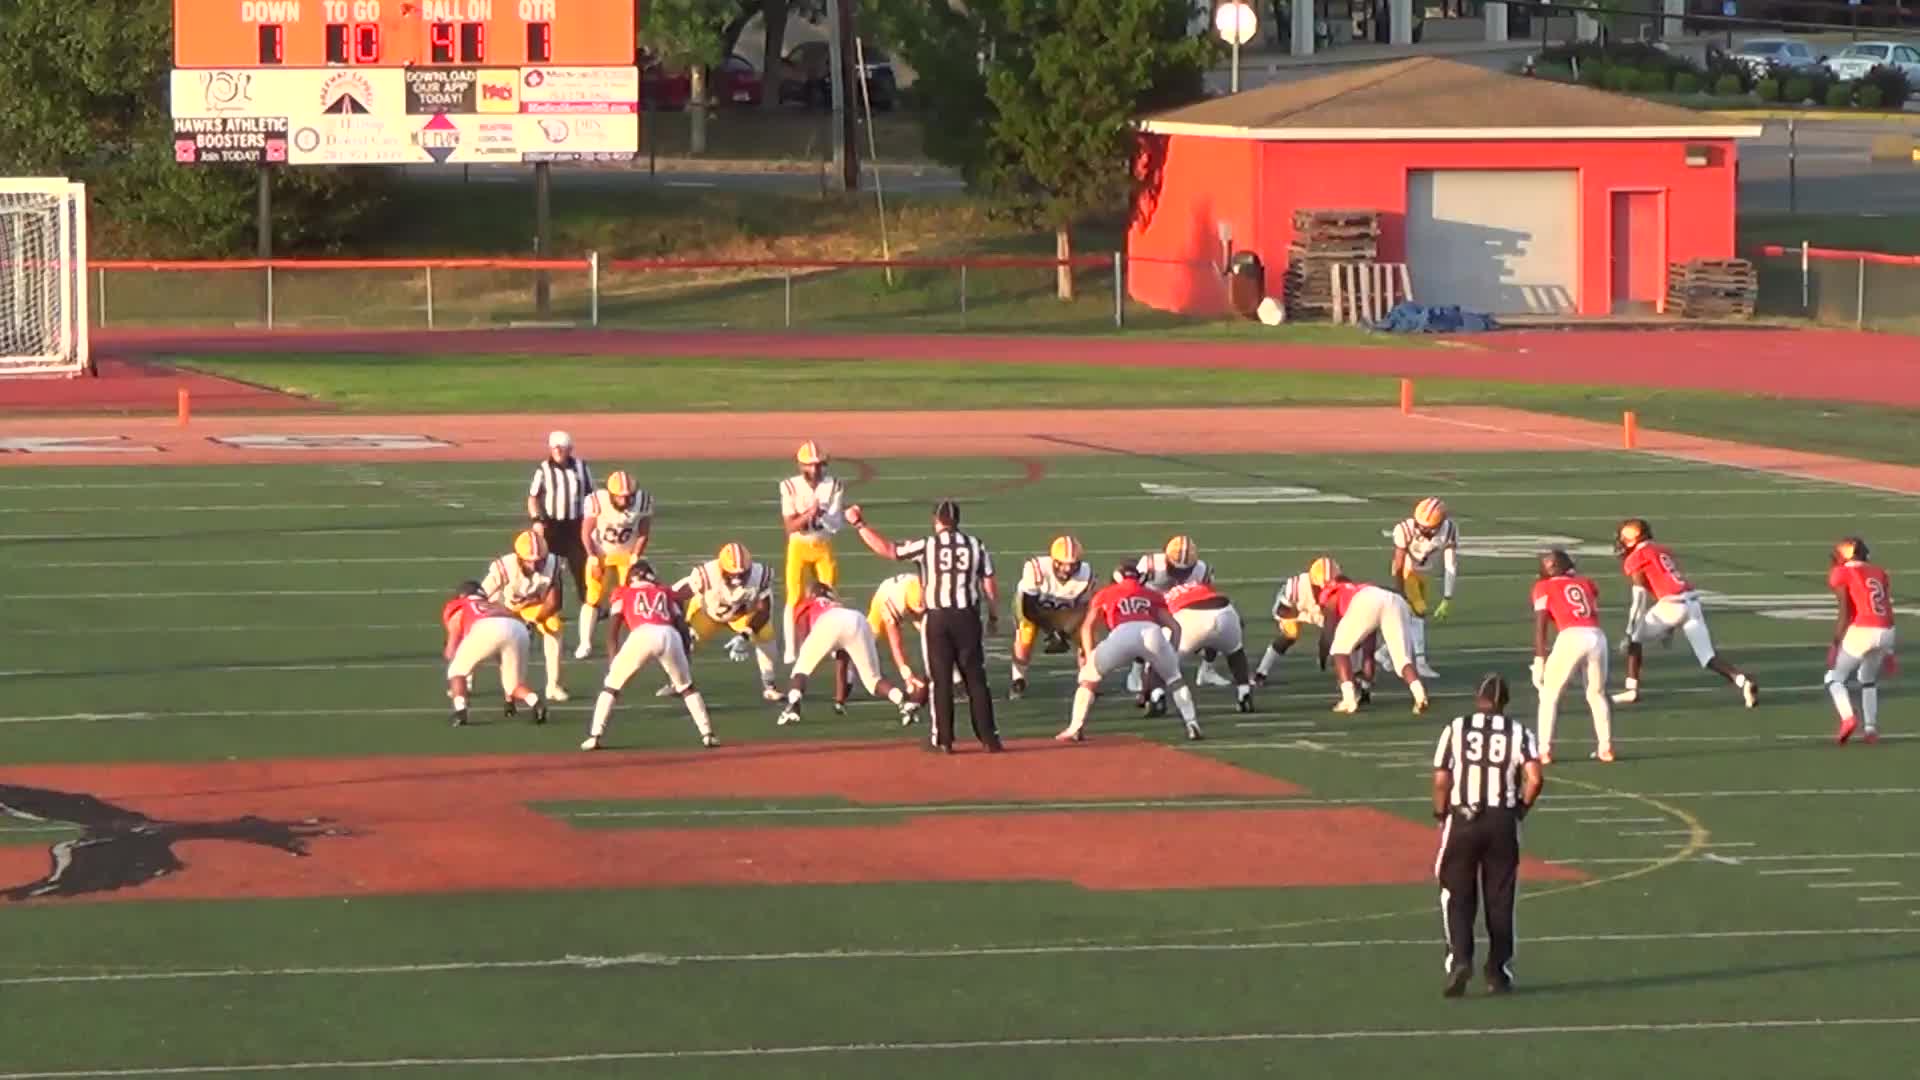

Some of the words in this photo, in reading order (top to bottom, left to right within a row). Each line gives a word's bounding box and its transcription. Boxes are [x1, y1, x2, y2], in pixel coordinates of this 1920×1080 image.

[241, 1, 300, 22] DOWN
[323, 1, 347, 21] TO
[353, 1, 381, 21] GO
[422, 1, 464, 20] BALL
[467, 1, 492, 20] ON
[519, 1, 557, 20] QTR
[335, 25, 379, 62] 10
[431, 24, 484, 61] 41
[406, 70, 476, 81] DOWNLOAD
[412, 81, 441, 93] OUR
[443, 81, 469, 92] APP
[419, 92, 463, 104] TODAY!
[174, 118, 223, 132] HAWKS
[226, 117, 287, 132] ATHLETIC
[196, 133, 265, 148] BOOSTERS
[938, 547, 970, 571] 93
[633, 591, 670, 620] 44
[1563, 582, 1592, 618] 9
[1865, 576, 1887, 616] 2
[1465, 732, 1508, 763] 38
